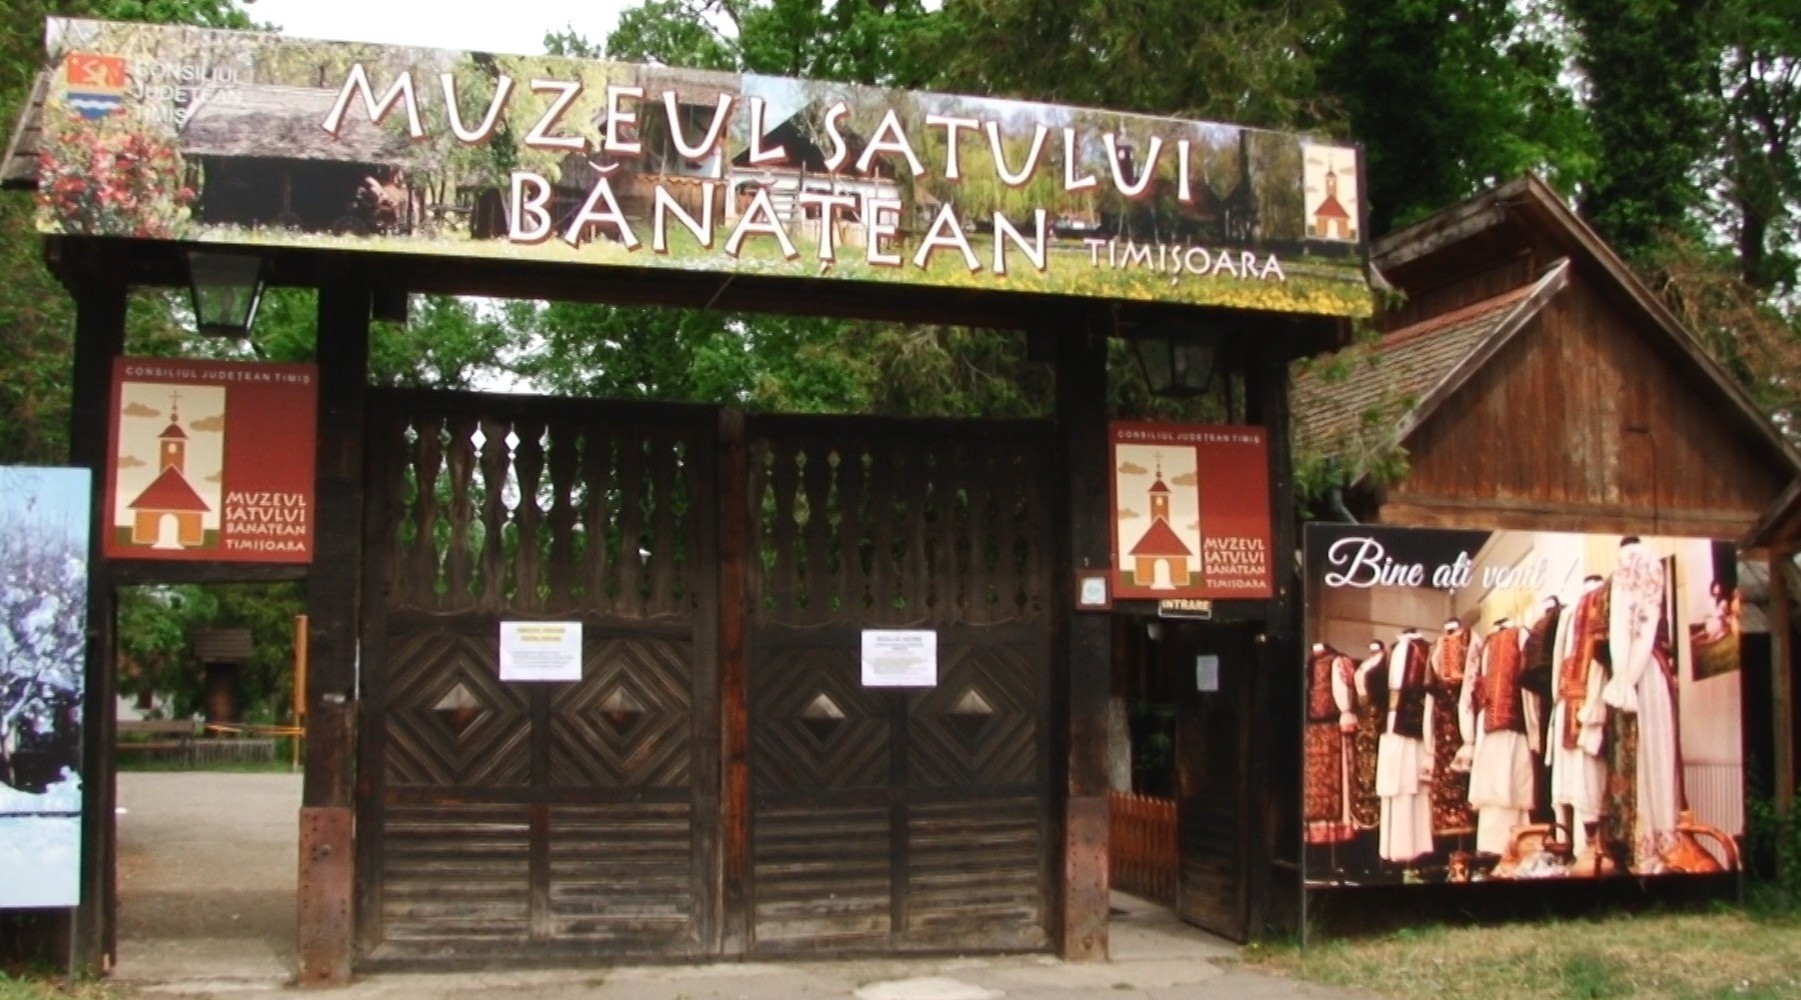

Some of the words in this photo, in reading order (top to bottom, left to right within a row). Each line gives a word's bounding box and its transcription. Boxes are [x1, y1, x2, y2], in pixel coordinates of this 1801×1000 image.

[321, 62, 787, 163] MUZEUL
[823, 100, 1192, 204] SATULUI
[508, 162, 1051, 274] BĂNĂȚEAN
[1083, 237, 1286, 285] TIMIȘOARA
[125, 366, 197, 378] CONSILIUL
[1117, 429, 1174, 440] CONSILIUL
[225, 492, 306, 507] MUZEUL
[225, 506, 305, 521] SATULUI
[1204, 537, 1265, 550] MUZEUL
[1205, 551, 1264, 564] SATULUI
[1324, 536, 1425, 588] Bine
[1482, 557, 1546, 588] venit
[1161, 599, 1210, 610] INTRARE
